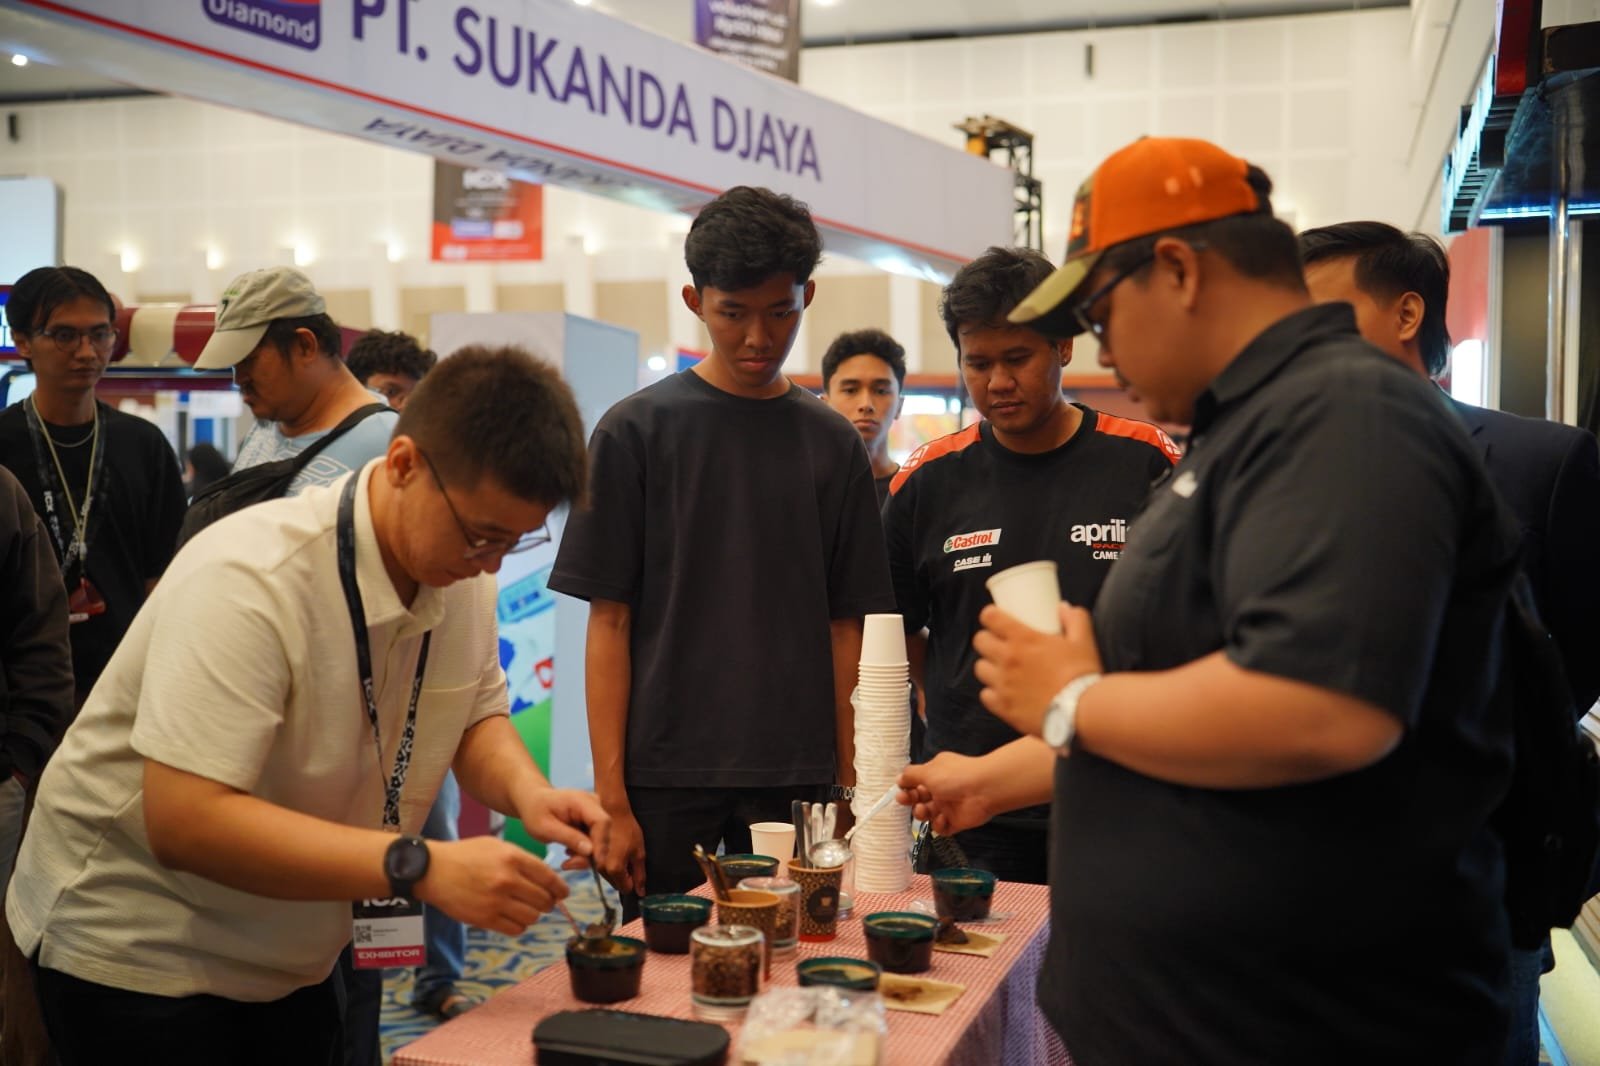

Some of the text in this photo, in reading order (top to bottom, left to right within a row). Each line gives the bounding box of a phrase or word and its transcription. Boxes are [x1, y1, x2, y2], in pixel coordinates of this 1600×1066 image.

[208, 0, 316, 44] Diamond
[352, 0, 822, 181] PT. SUKANDA DJAYA
[953, 532, 993, 549] Castrol
[1070, 518, 1131, 546] aprili
[954, 556, 981, 567] CASE
[358, 949, 420, 960] EXHIBITOR
